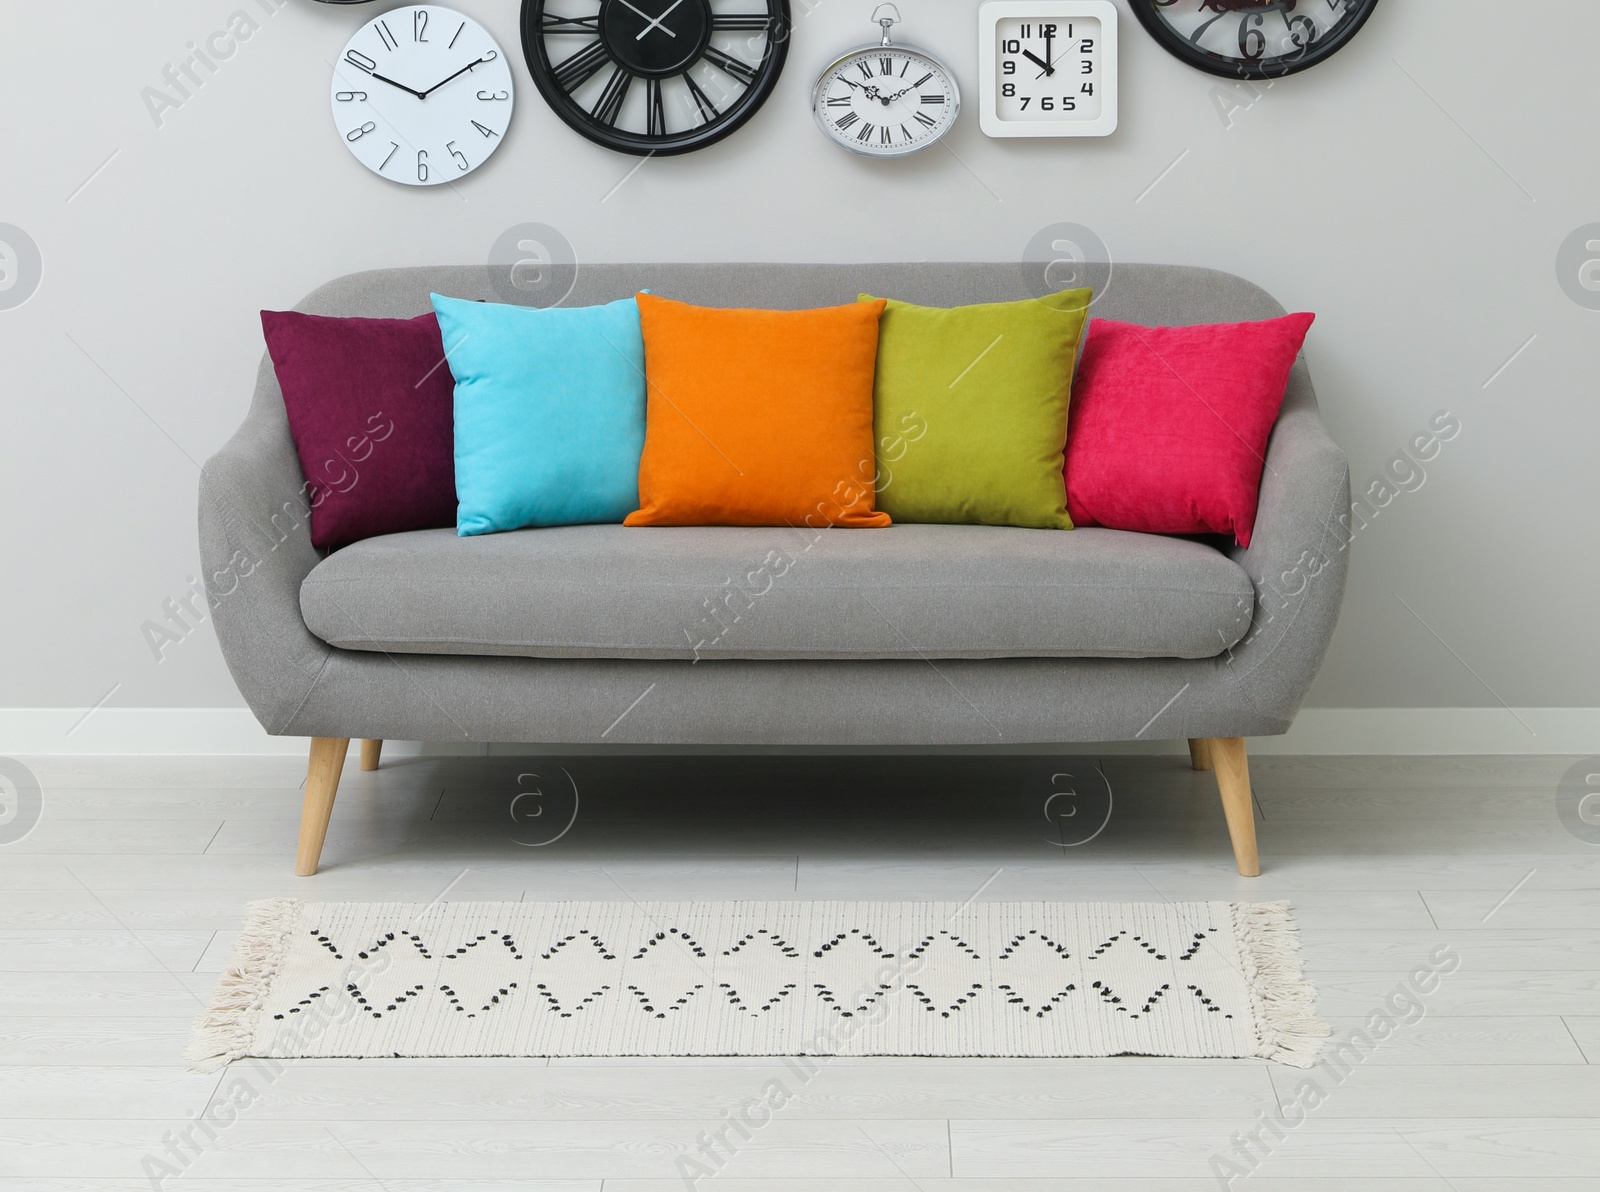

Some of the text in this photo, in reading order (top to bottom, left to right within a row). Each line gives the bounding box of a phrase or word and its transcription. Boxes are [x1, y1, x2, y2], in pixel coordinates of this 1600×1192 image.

[414, 10, 429, 42] 12
[1021, 24, 1030, 38] 11
[1069, 24, 1072, 38] 1
[1238, 12, 1266, 59] 6
[1002, 39, 1020, 54] 10
[1080, 39, 1094, 53] 2
[344, 49, 376, 75] 10
[1003, 61, 1015, 75] 9
[1081, 60, 1092, 74] 3
[336, 91, 367, 101] 9
[476, 90, 508, 101] 3
[1002, 83, 1015, 97] 8
[1080, 83, 1094, 96] 4
[1020, 97, 1031, 111] 7
[1041, 97, 1054, 111] 6
[1063, 97, 1076, 111] 5
[347, 121, 375, 141] 8
[470, 120, 499, 138] 4
[379, 141, 399, 170] 7
[446, 141, 468, 170] 5
[417, 150, 428, 181] 6
